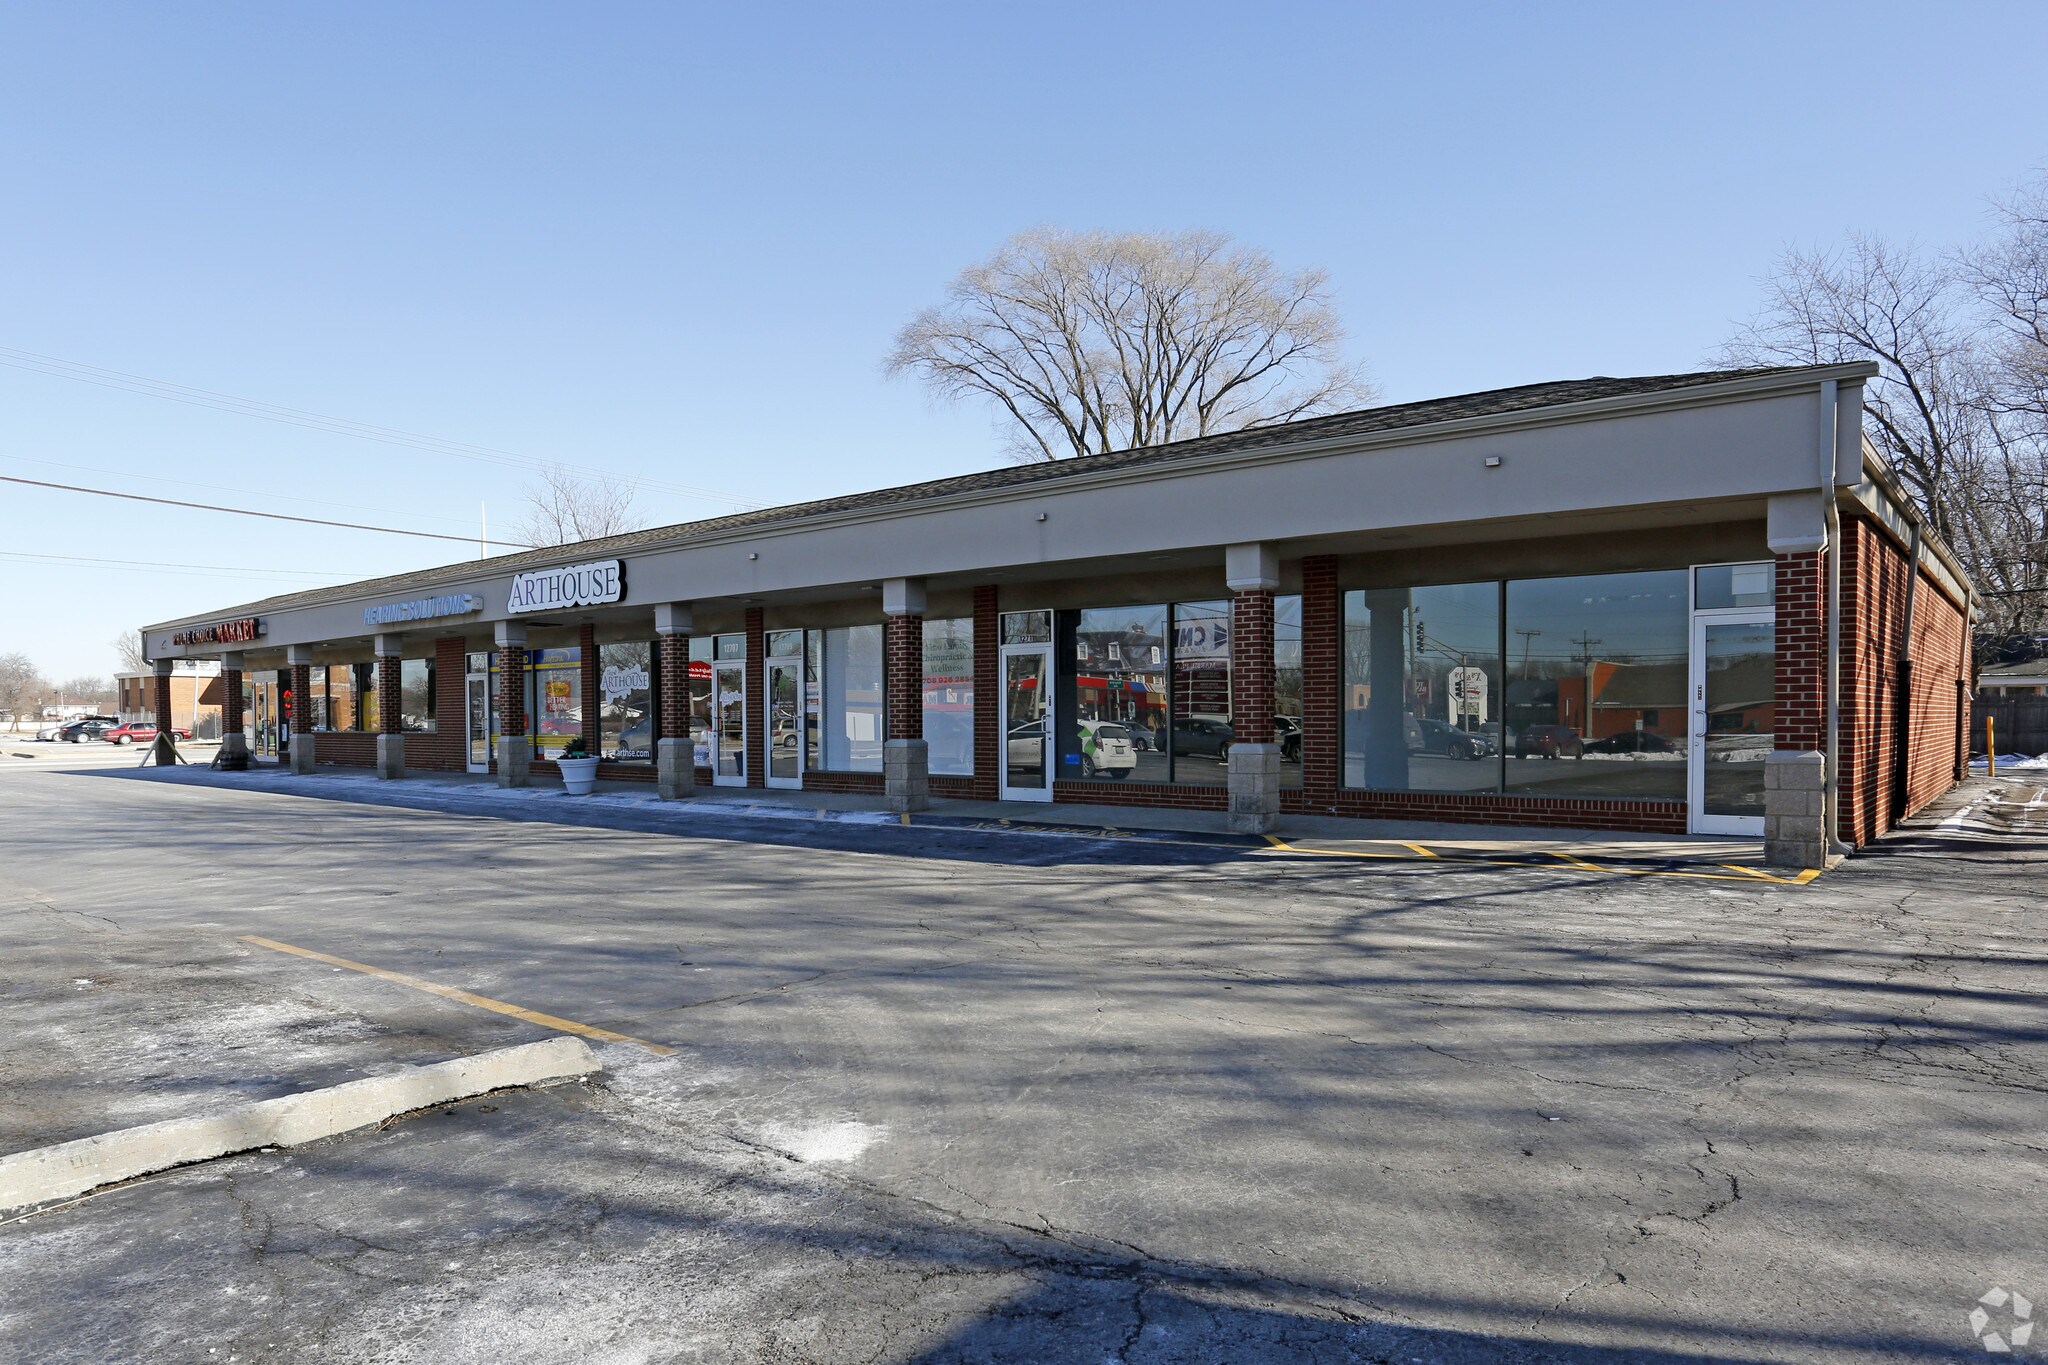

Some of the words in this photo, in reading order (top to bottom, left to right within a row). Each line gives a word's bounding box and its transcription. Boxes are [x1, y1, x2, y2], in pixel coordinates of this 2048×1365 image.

[511, 567, 617, 607] ARTHOUSE
[364, 603, 405, 625] HEARING
[407, 594, 468, 620] SOLUTIONS
[192, 627, 213, 643] CHOICE
[216, 618, 255, 644] MARKET
[723, 643, 739, 653] 12707
[930, 664, 964, 673] Wellness
[602, 675, 648, 688] ARTHOUSE
